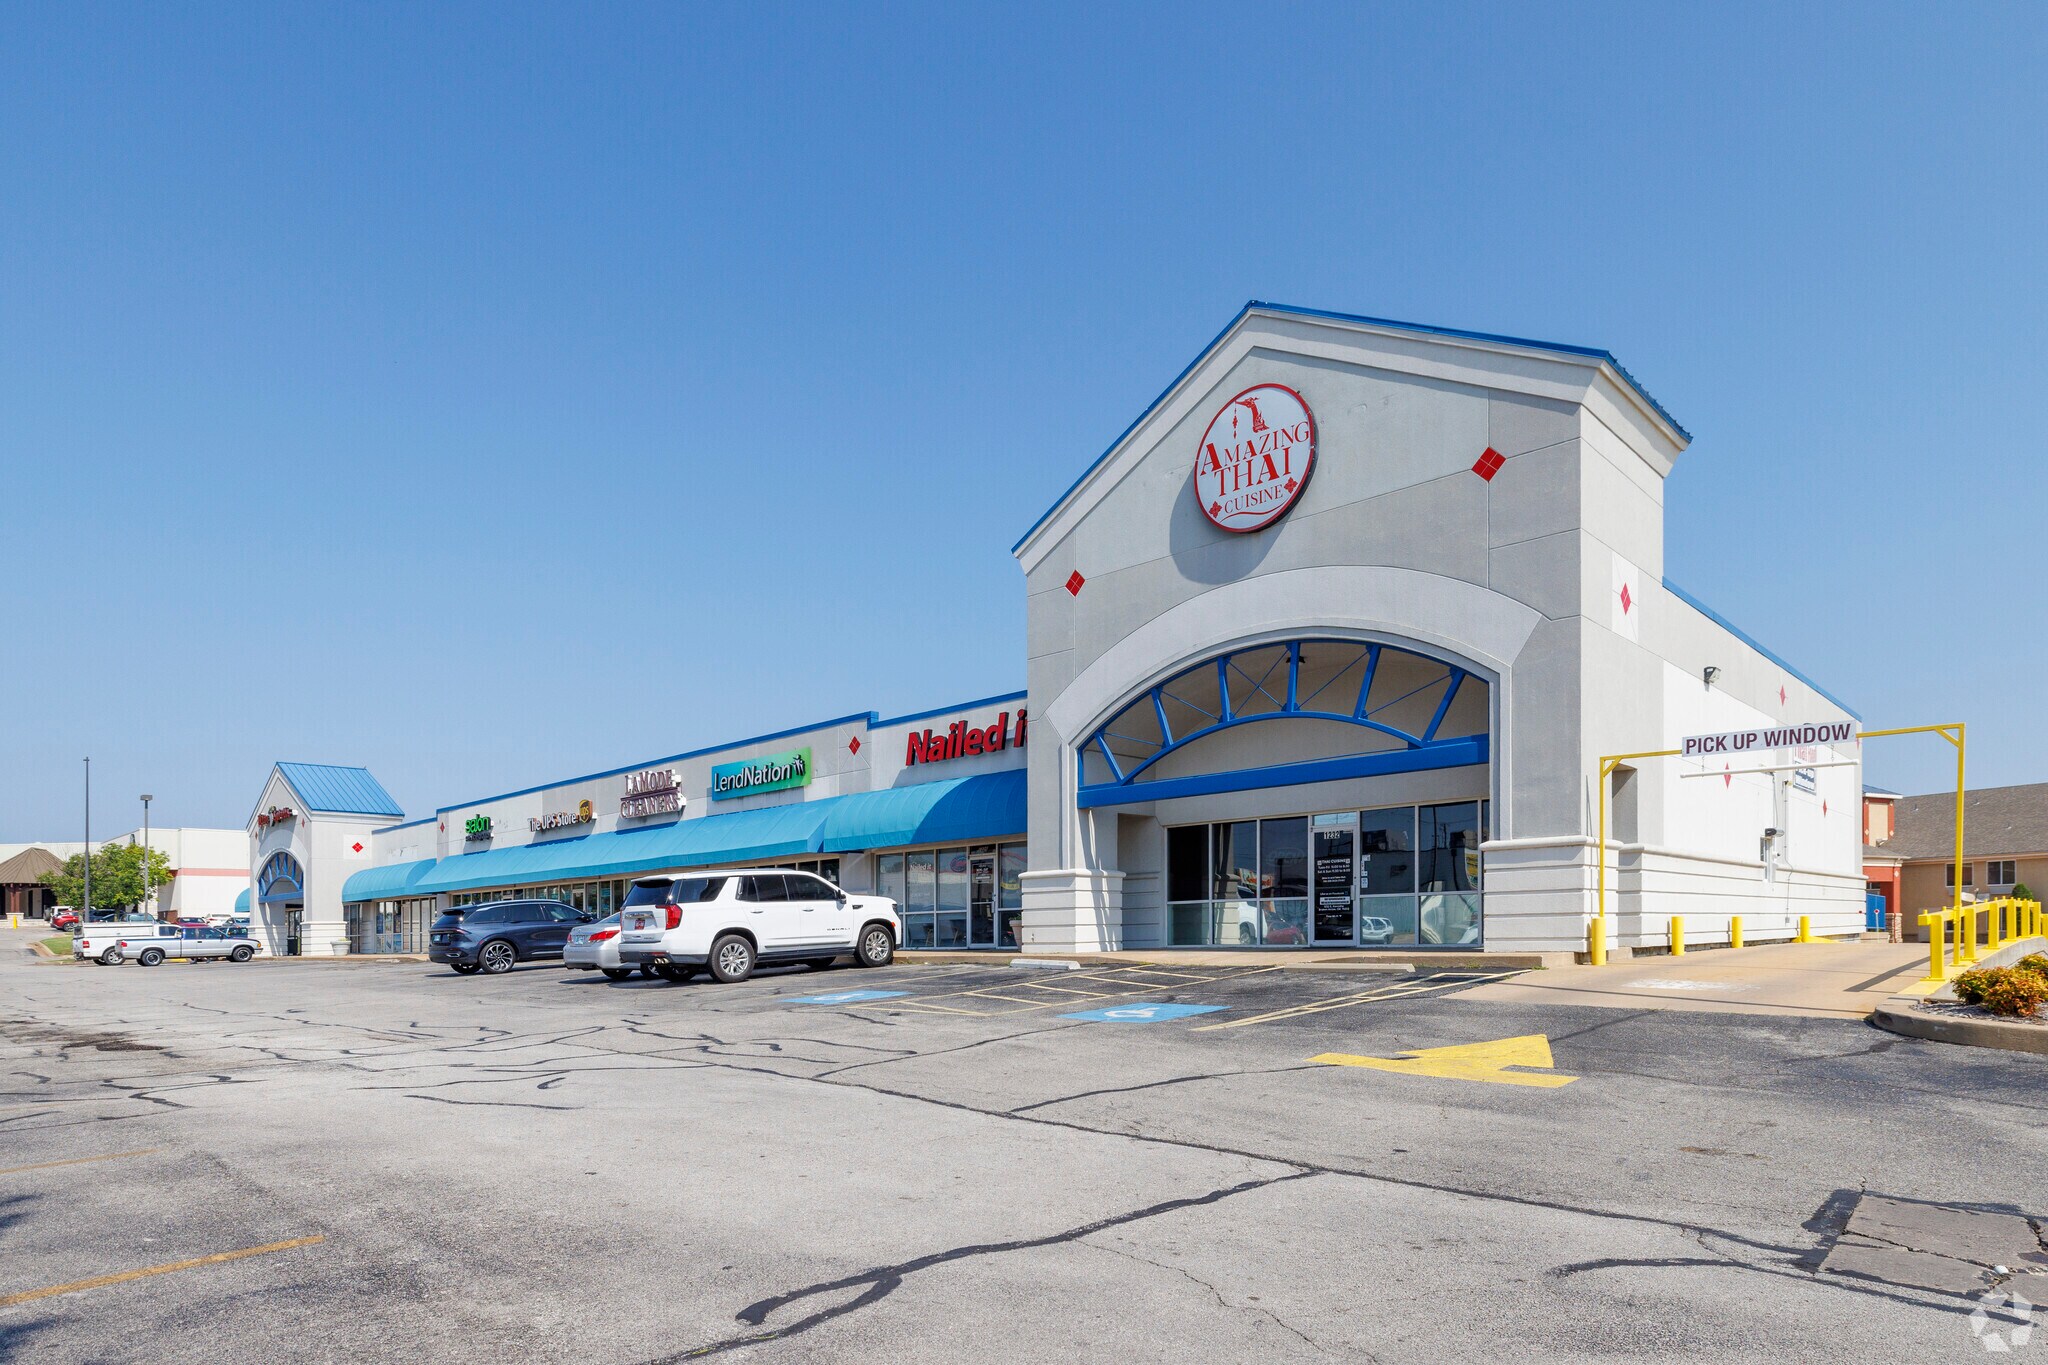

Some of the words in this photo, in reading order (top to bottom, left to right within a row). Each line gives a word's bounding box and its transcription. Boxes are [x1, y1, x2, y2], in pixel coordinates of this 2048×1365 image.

[1200, 421, 1309, 477] AMAZING
[1214, 446, 1291, 497] THAI
[1224, 484, 1284, 514] CUISINE
[905, 712, 1009, 766] Nailed
[1013, 708, 1027, 748] i
[1686, 735, 1727, 755] PICK
[1733, 732, 1758, 750] UP
[1763, 723, 1851, 747] WINDOW
[714, 762, 792, 792] LendNation
[620, 792, 680, 819] CLEANERS
[465, 814, 490, 834] salon
[527, 817, 541, 832] The
[541, 814, 556, 830] UPS
[1324, 831, 1340, 839] 1232
